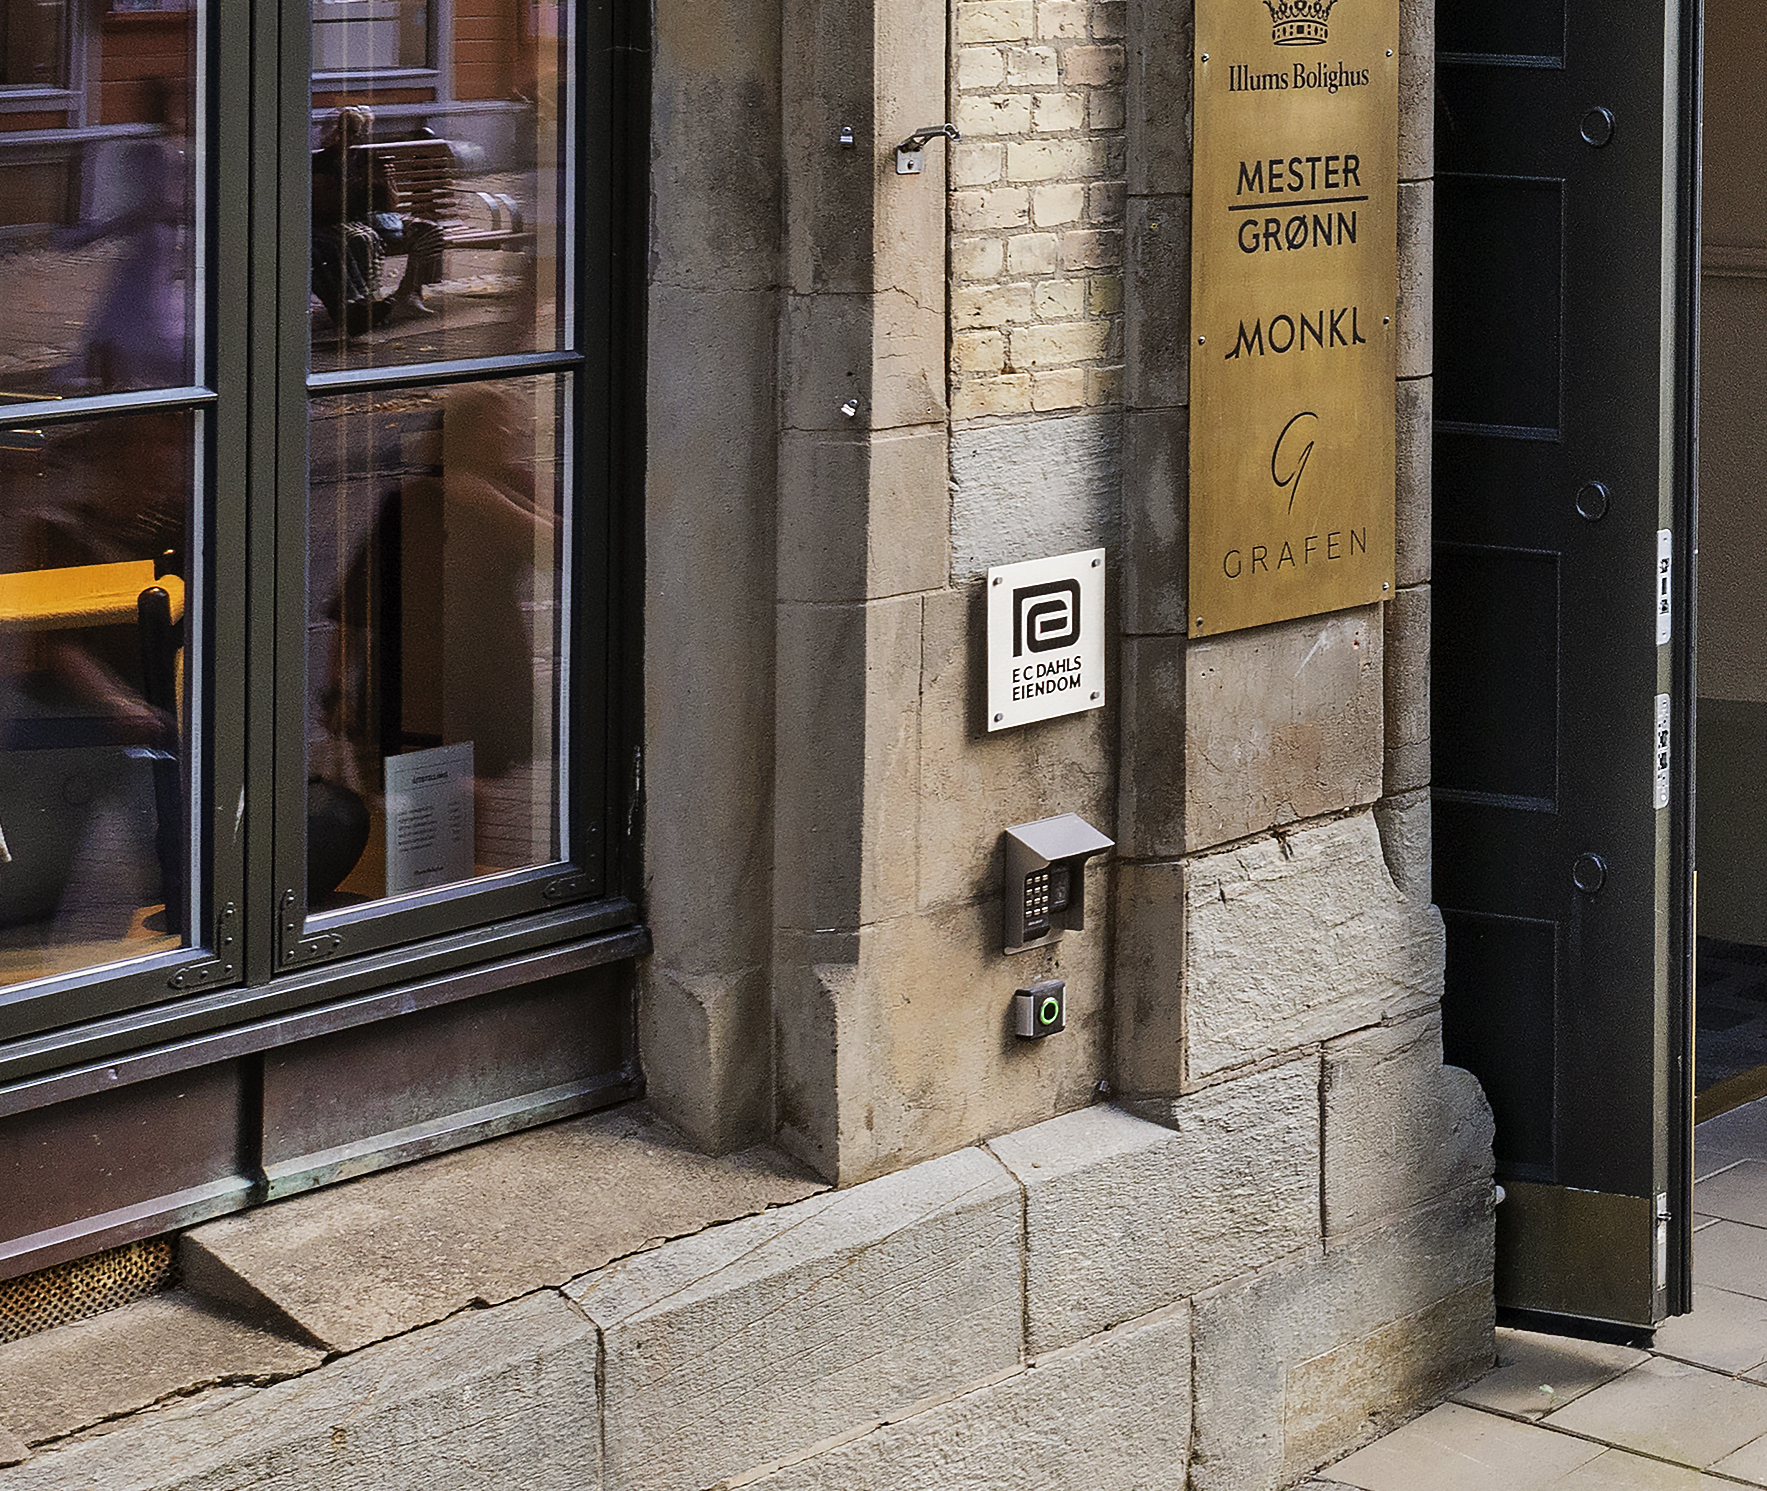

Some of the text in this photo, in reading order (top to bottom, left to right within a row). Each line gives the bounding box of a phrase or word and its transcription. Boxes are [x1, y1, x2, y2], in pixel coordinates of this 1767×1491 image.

[1228, 61, 1370, 94] Illums Bolighus
[1236, 154, 1361, 196] MESTER
[1238, 211, 1357, 254] GRØNN
[1224, 527, 1367, 579] GRAFEN
[1012, 655, 1082, 684] E C DAHLS
[1012, 673, 1082, 702] EIENDOM
